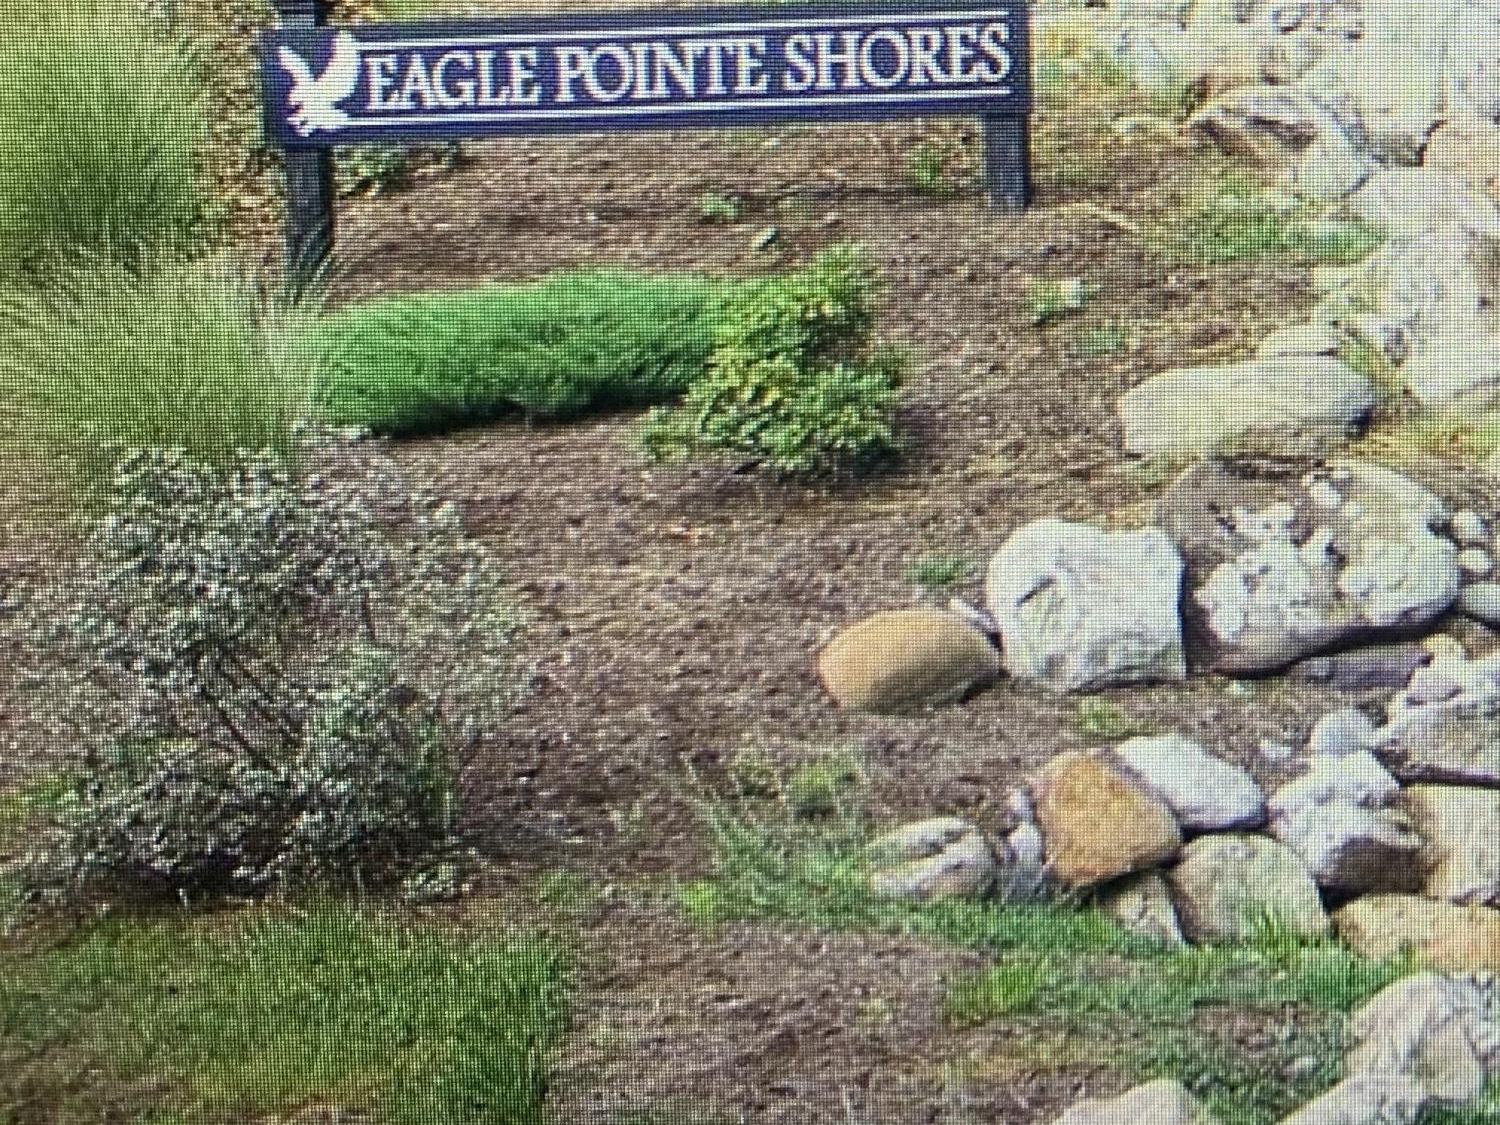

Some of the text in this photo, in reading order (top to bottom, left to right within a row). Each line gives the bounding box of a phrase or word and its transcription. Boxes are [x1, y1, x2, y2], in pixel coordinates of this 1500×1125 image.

[364, 23, 1010, 110] EAGLE POINTE SHORES
